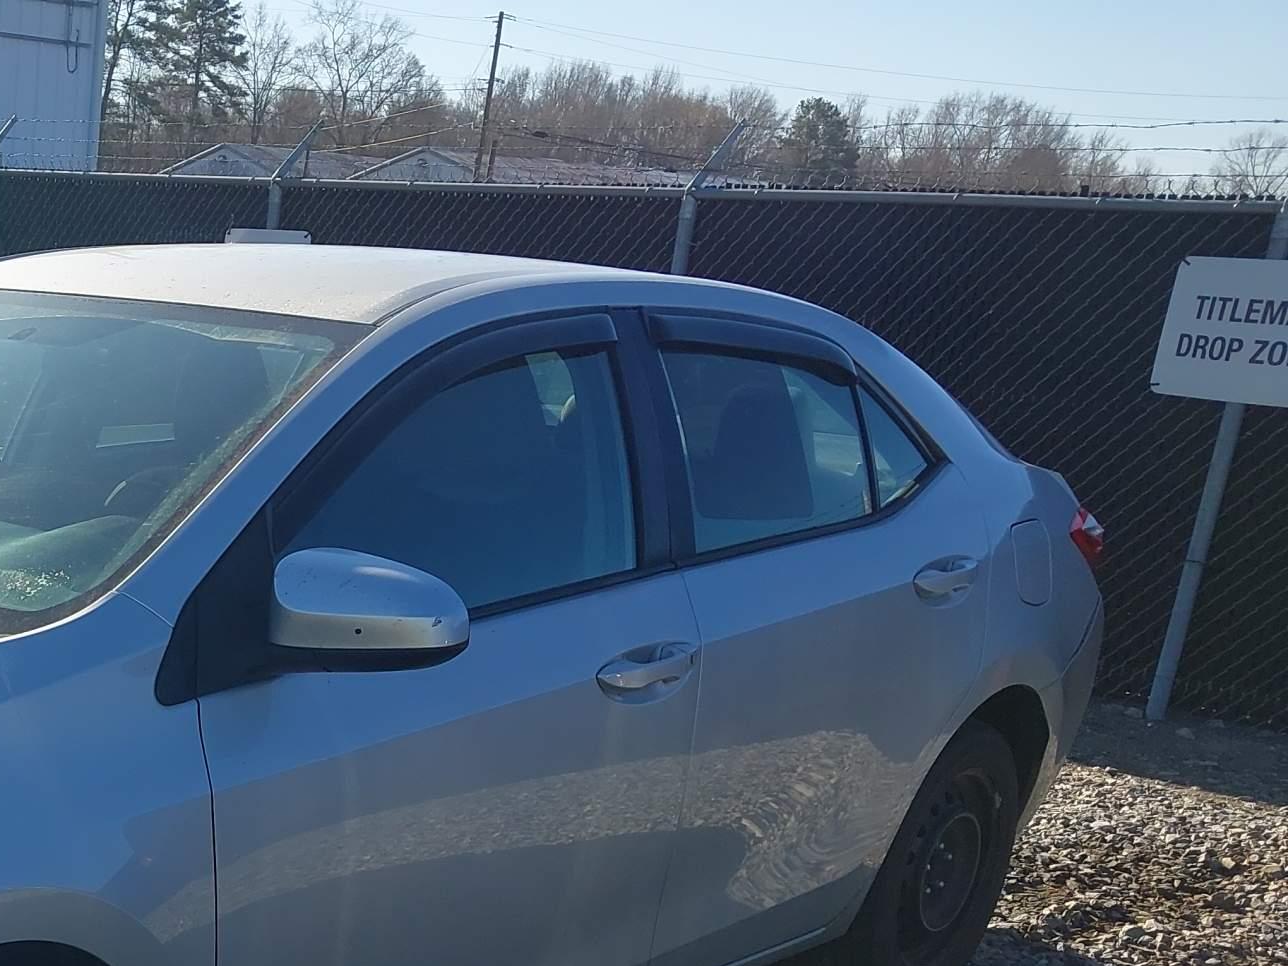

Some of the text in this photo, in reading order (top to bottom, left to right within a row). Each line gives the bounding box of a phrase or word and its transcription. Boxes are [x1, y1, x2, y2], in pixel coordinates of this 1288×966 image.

[1195, 295, 1288, 326] TITLEM
[1175, 332, 1288, 366] DROP ZO
